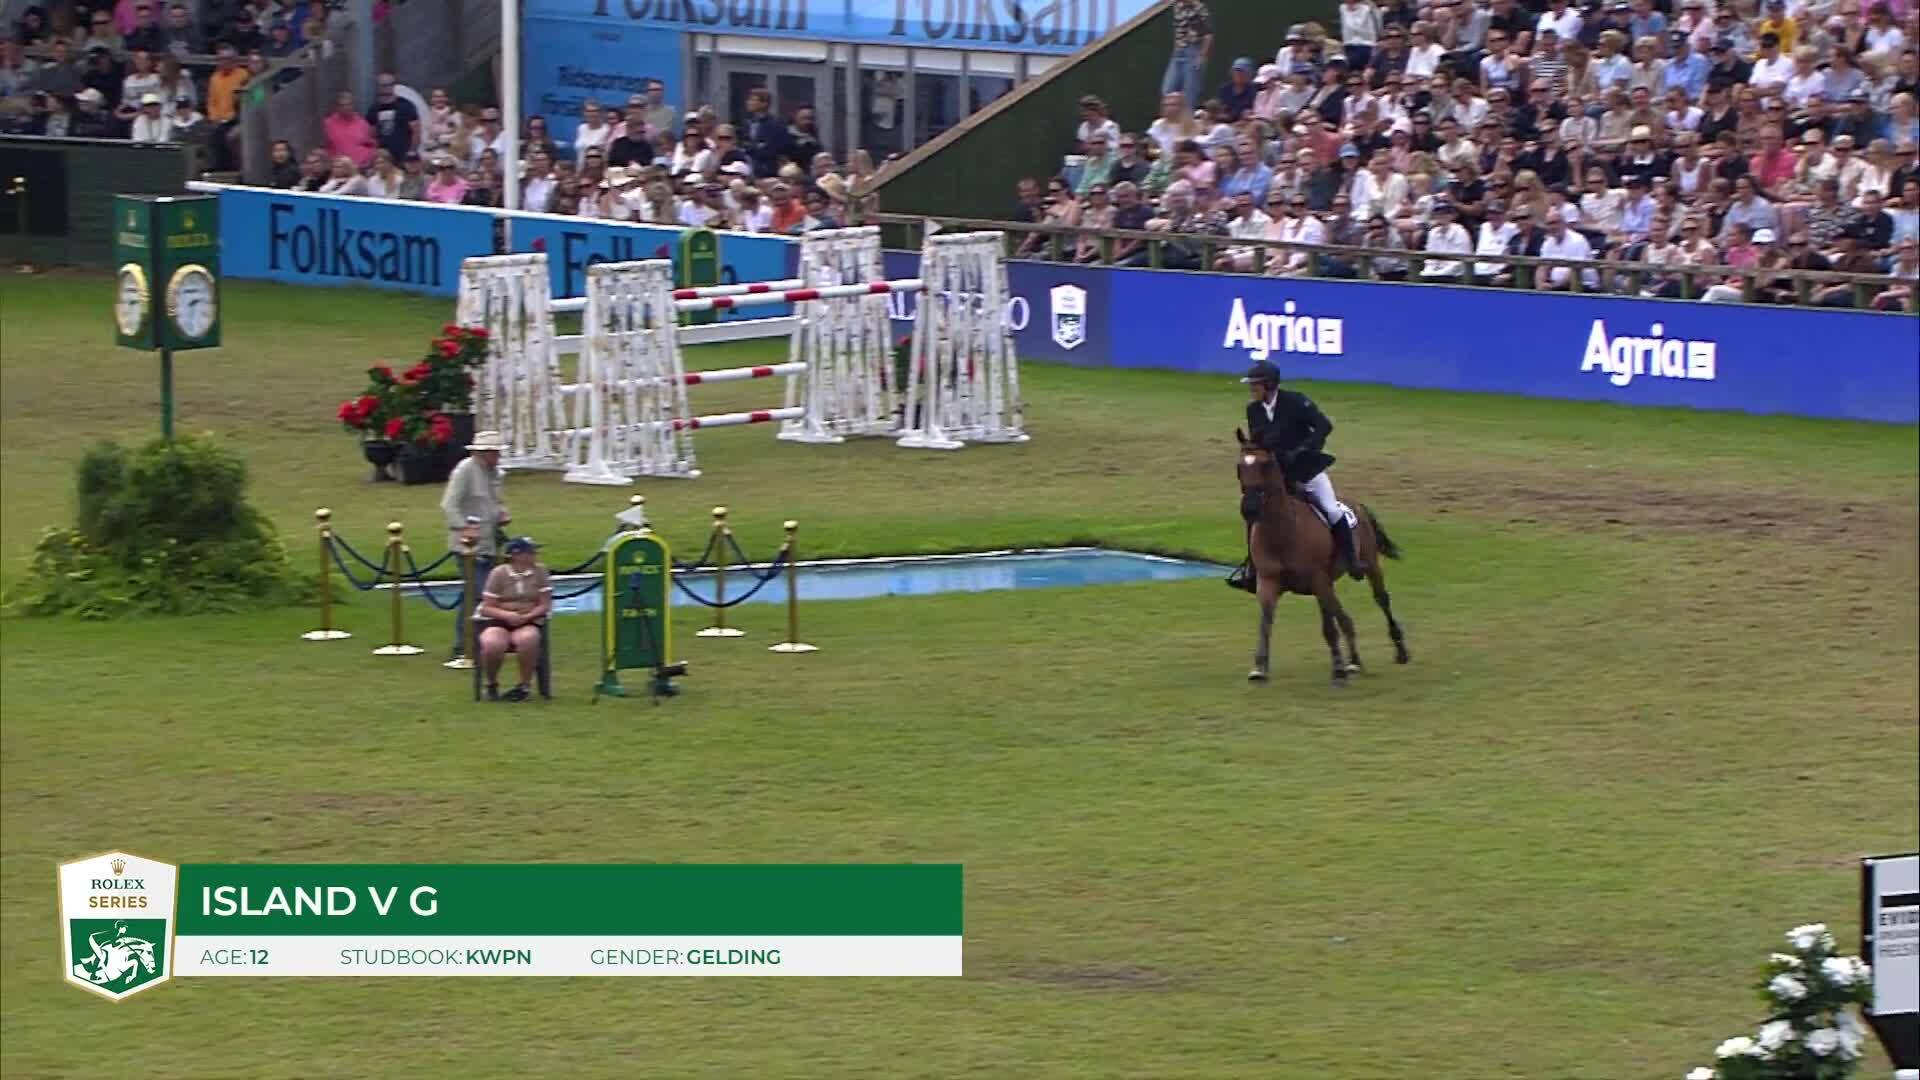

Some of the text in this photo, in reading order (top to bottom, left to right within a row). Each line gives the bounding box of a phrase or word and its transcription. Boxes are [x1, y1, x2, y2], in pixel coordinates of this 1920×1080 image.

[268, 203, 441, 286] Folksam
[1224, 297, 1318, 361] Agria
[1581, 319, 1686, 386] Agria
